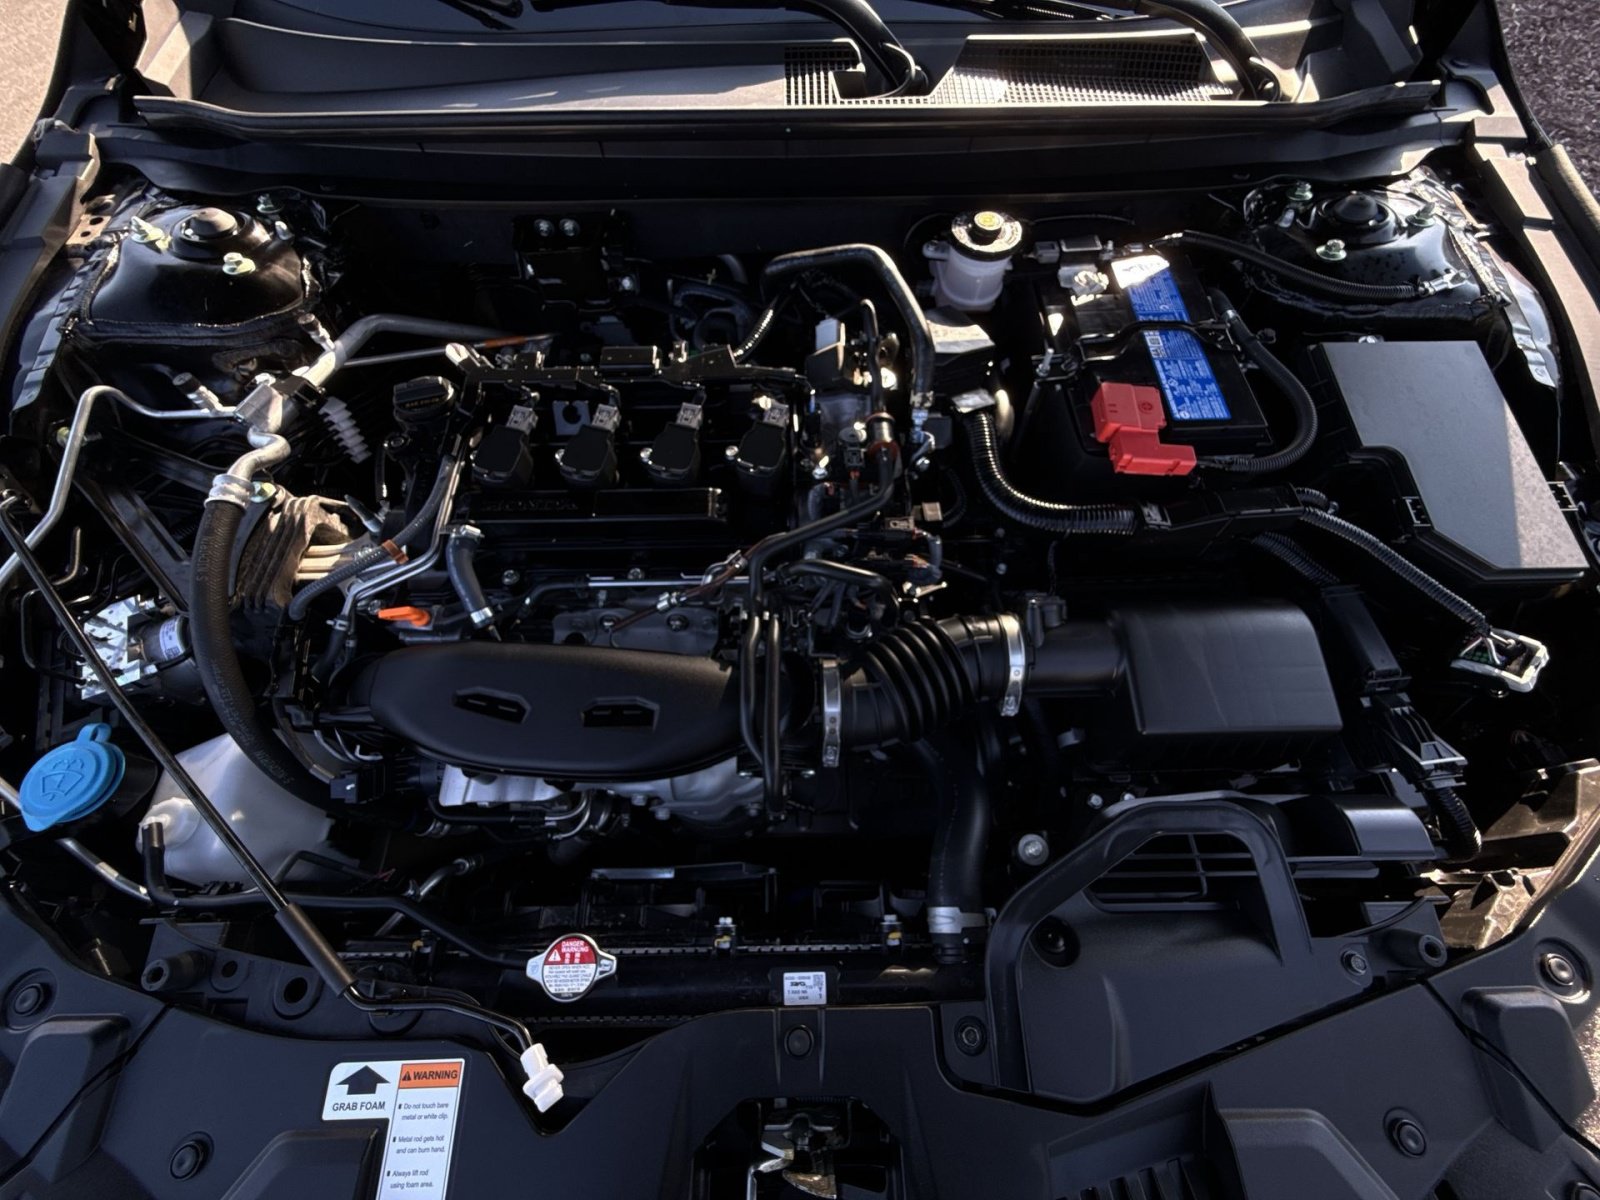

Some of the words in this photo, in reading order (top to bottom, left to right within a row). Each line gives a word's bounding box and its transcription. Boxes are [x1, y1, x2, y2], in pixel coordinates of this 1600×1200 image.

[413, 1070, 458, 1080] WARNING
[332, 1102, 358, 1111] GRAB
[360, 1101, 385, 1110] FOAM
